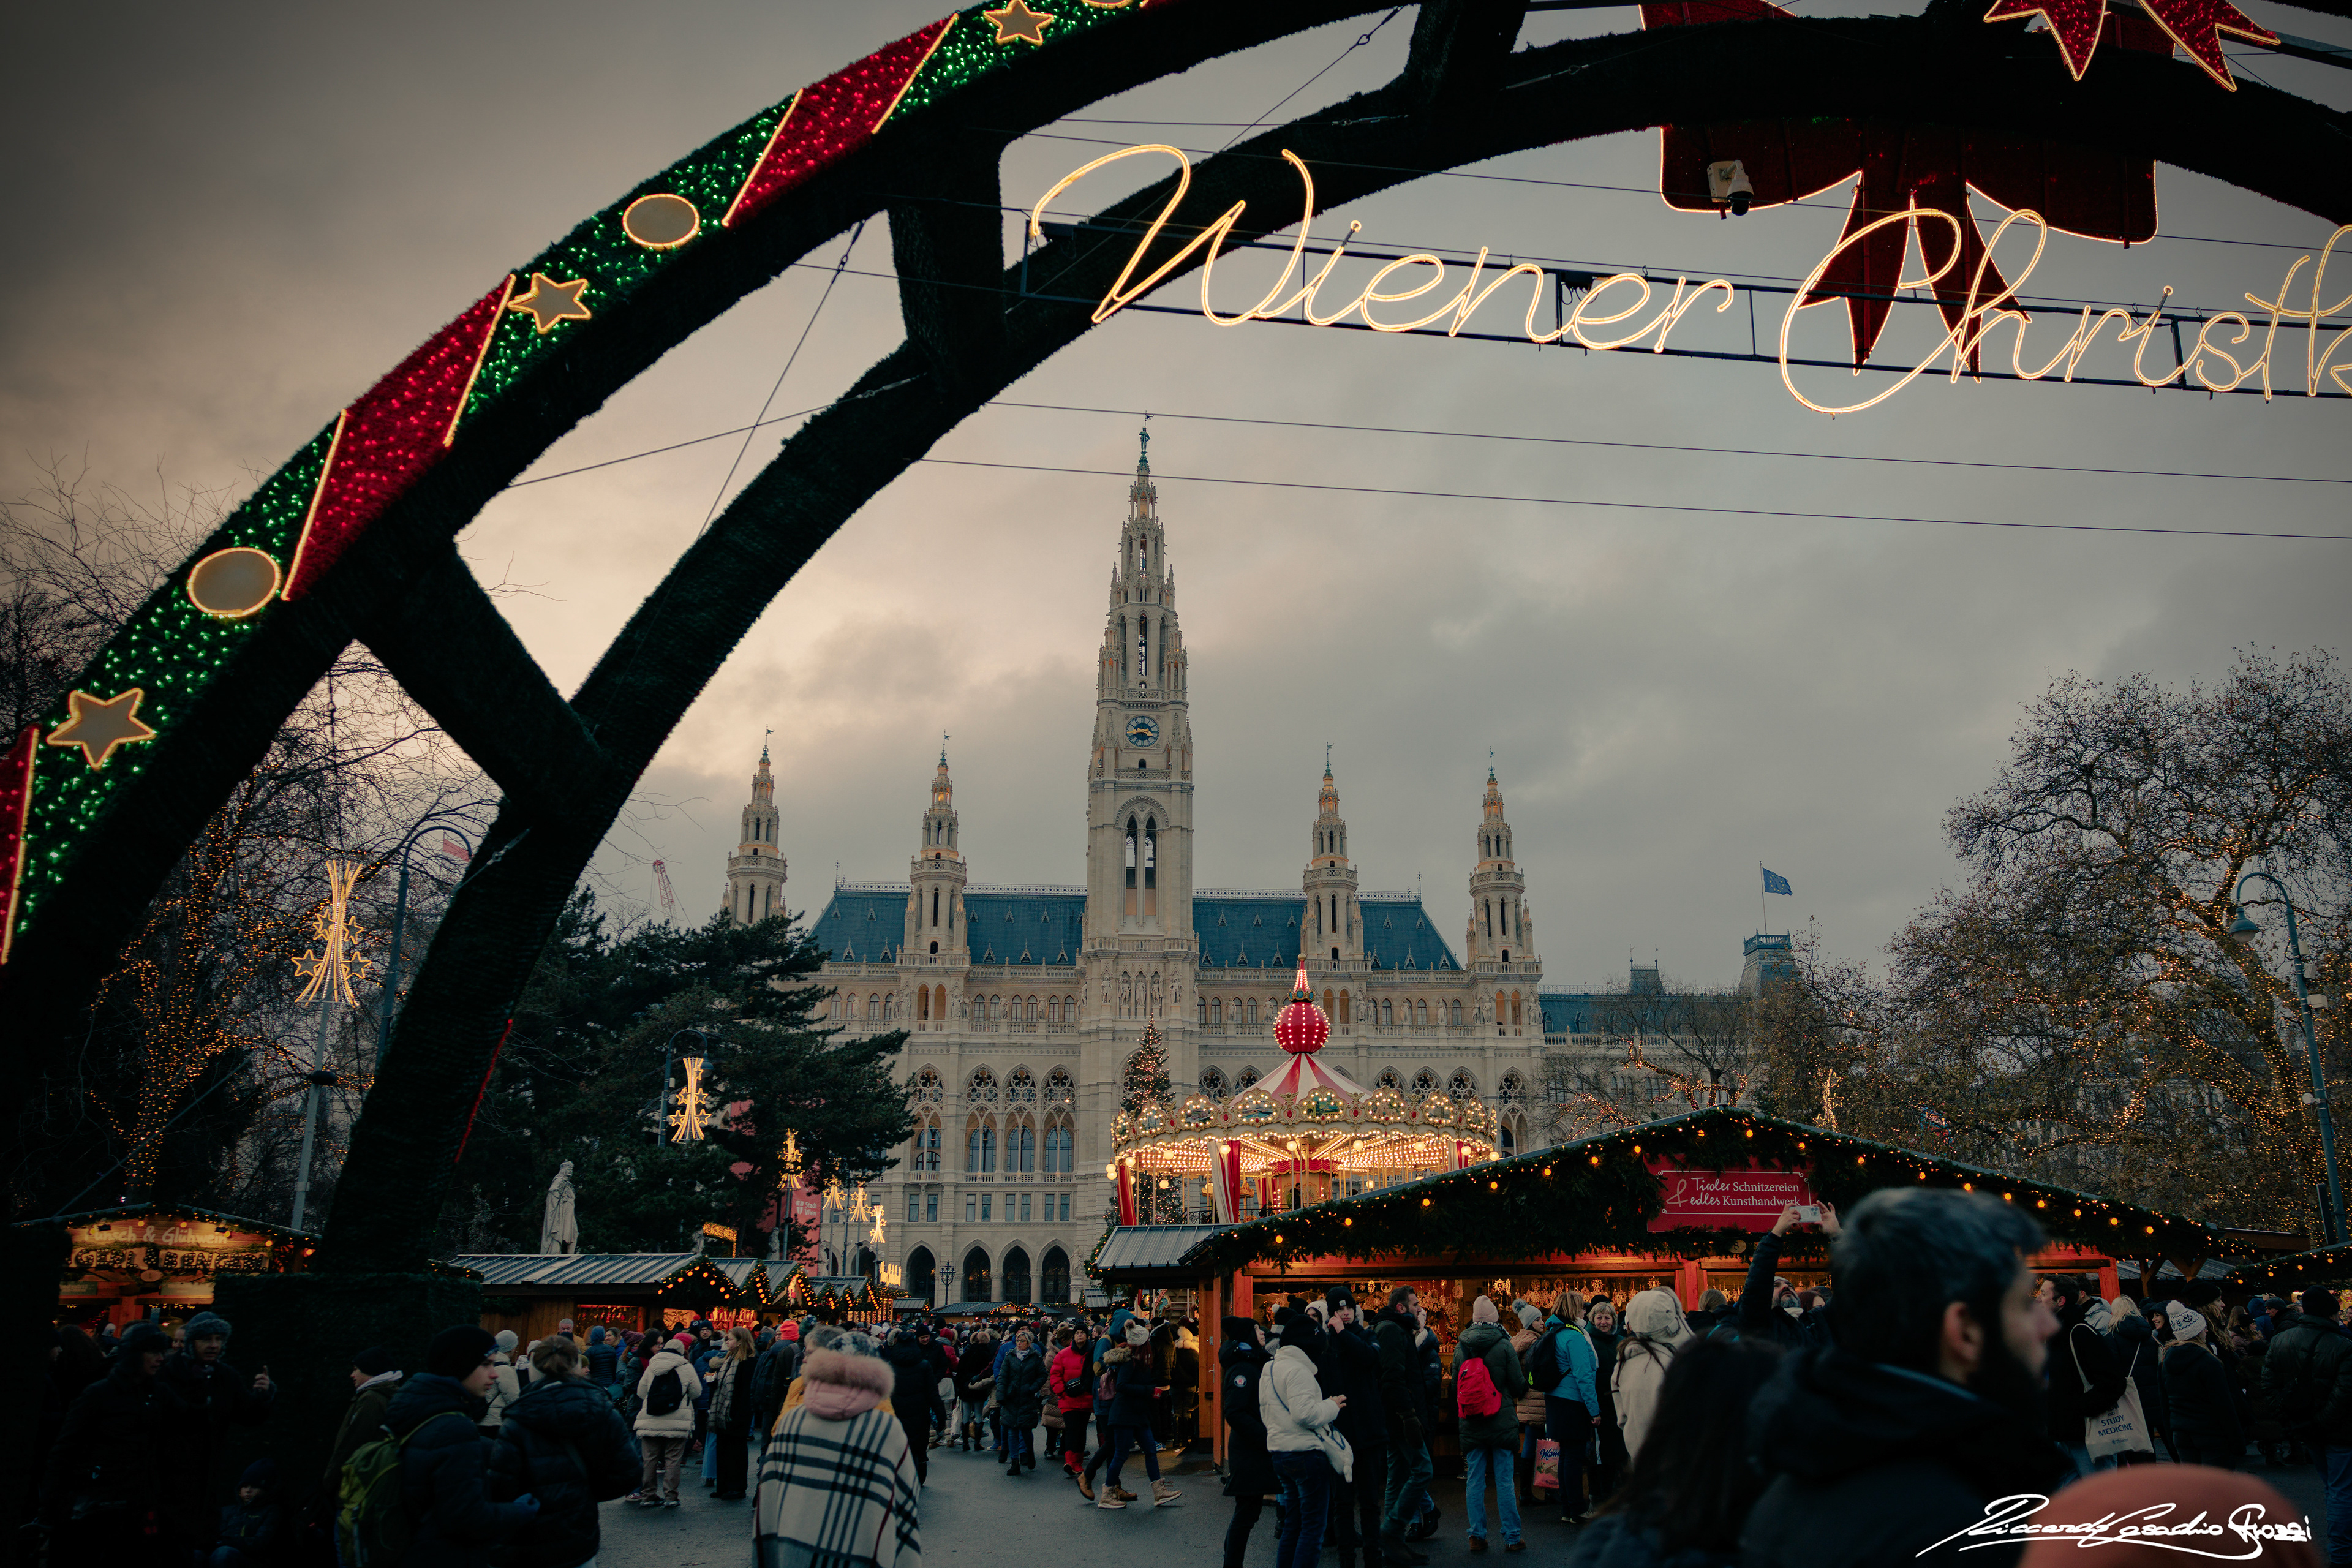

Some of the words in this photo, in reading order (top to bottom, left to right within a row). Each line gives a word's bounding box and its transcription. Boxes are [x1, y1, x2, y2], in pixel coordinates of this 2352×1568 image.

[1030, 143, 1735, 354] Wiener
[1691, 1177, 1730, 1192] Tiroler
[1733, 1182, 1800, 1192] Schnitzereien
[1689, 1192, 1721, 1206] edles
[1722, 1196, 1801, 1206] Kunsthandwerk
[143, 1225, 156, 1243] &
[162, 1227, 228, 1245] Glühwein
[1734, 1242, 1740, 1250] 8
[164, 1250, 270, 1272] BENGERL
[2101, 1415, 2124, 1427] STUDY
[2098, 1423, 2133, 1436] MEDICINE
